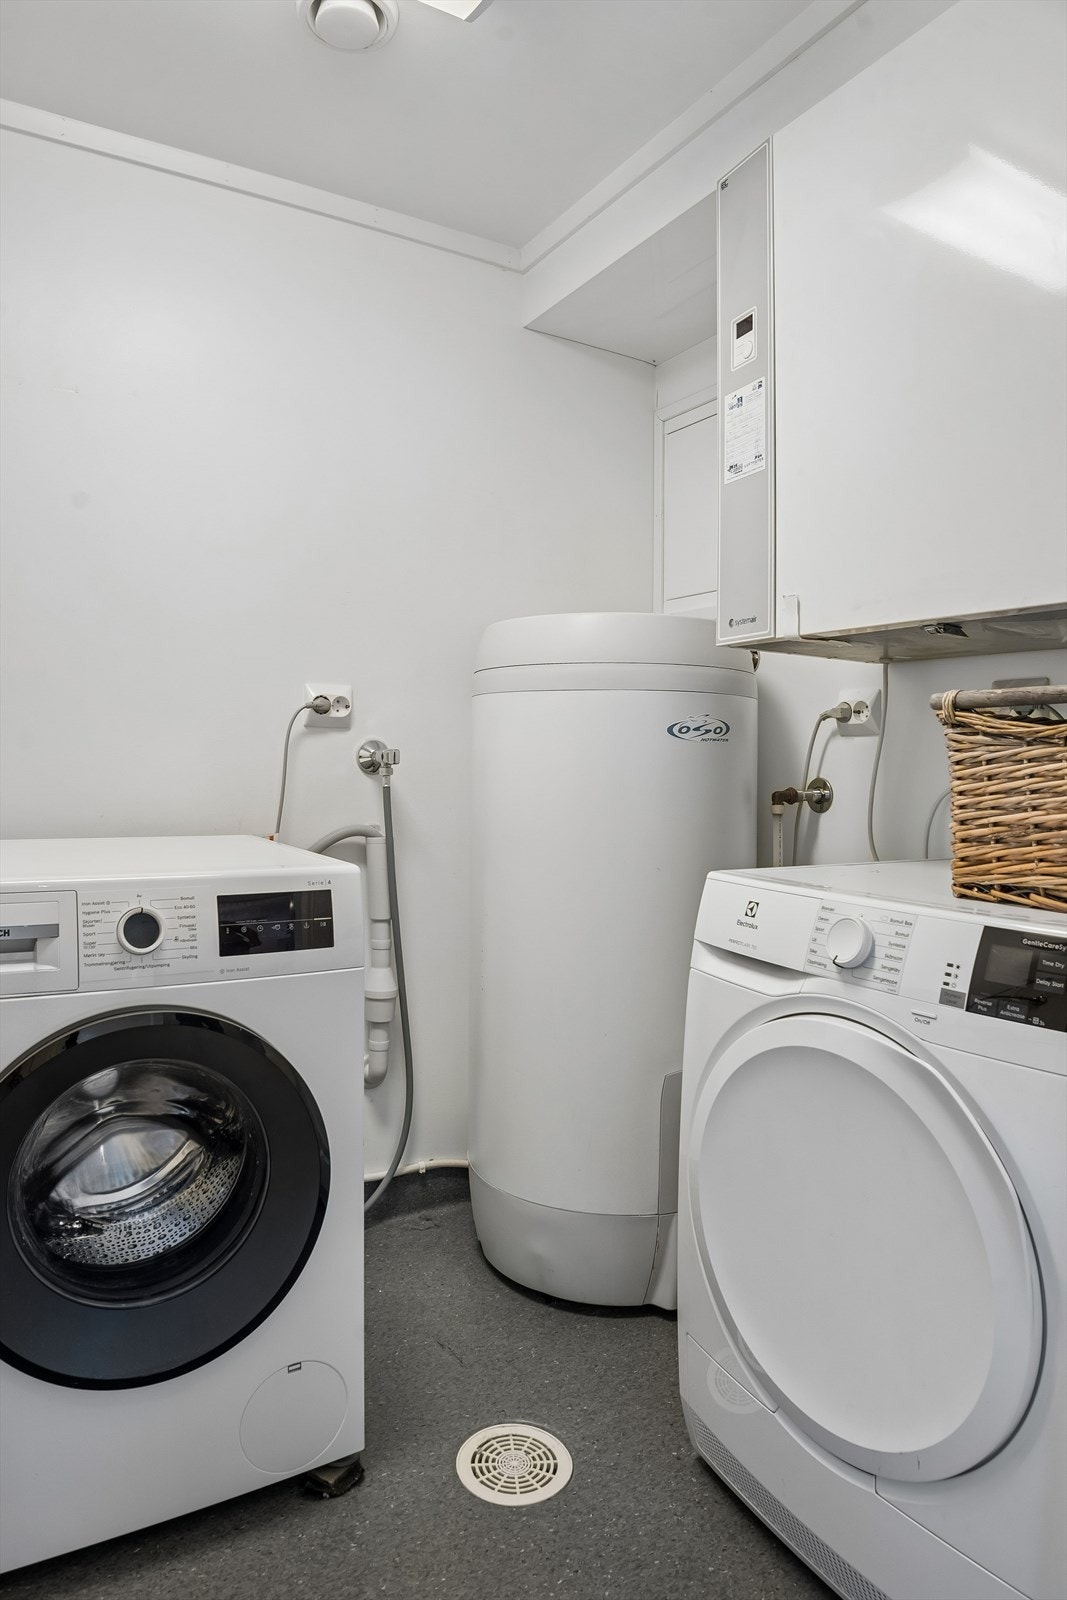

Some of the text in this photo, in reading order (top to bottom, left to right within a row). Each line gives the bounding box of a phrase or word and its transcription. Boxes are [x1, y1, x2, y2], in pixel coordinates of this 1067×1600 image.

[734, 615, 757, 627] systemair
[736, 918, 758, 930] Electrolux
[1042, 959, 1065, 969] Time Dry
[1035, 978, 1051, 987] Delay
[974, 997, 993, 1007] Reverse
[1006, 1004, 1020, 1012] Extra
[1000, 1009, 1026, 1020] Anticrease
[914, 1017, 931, 1026] On/Off
